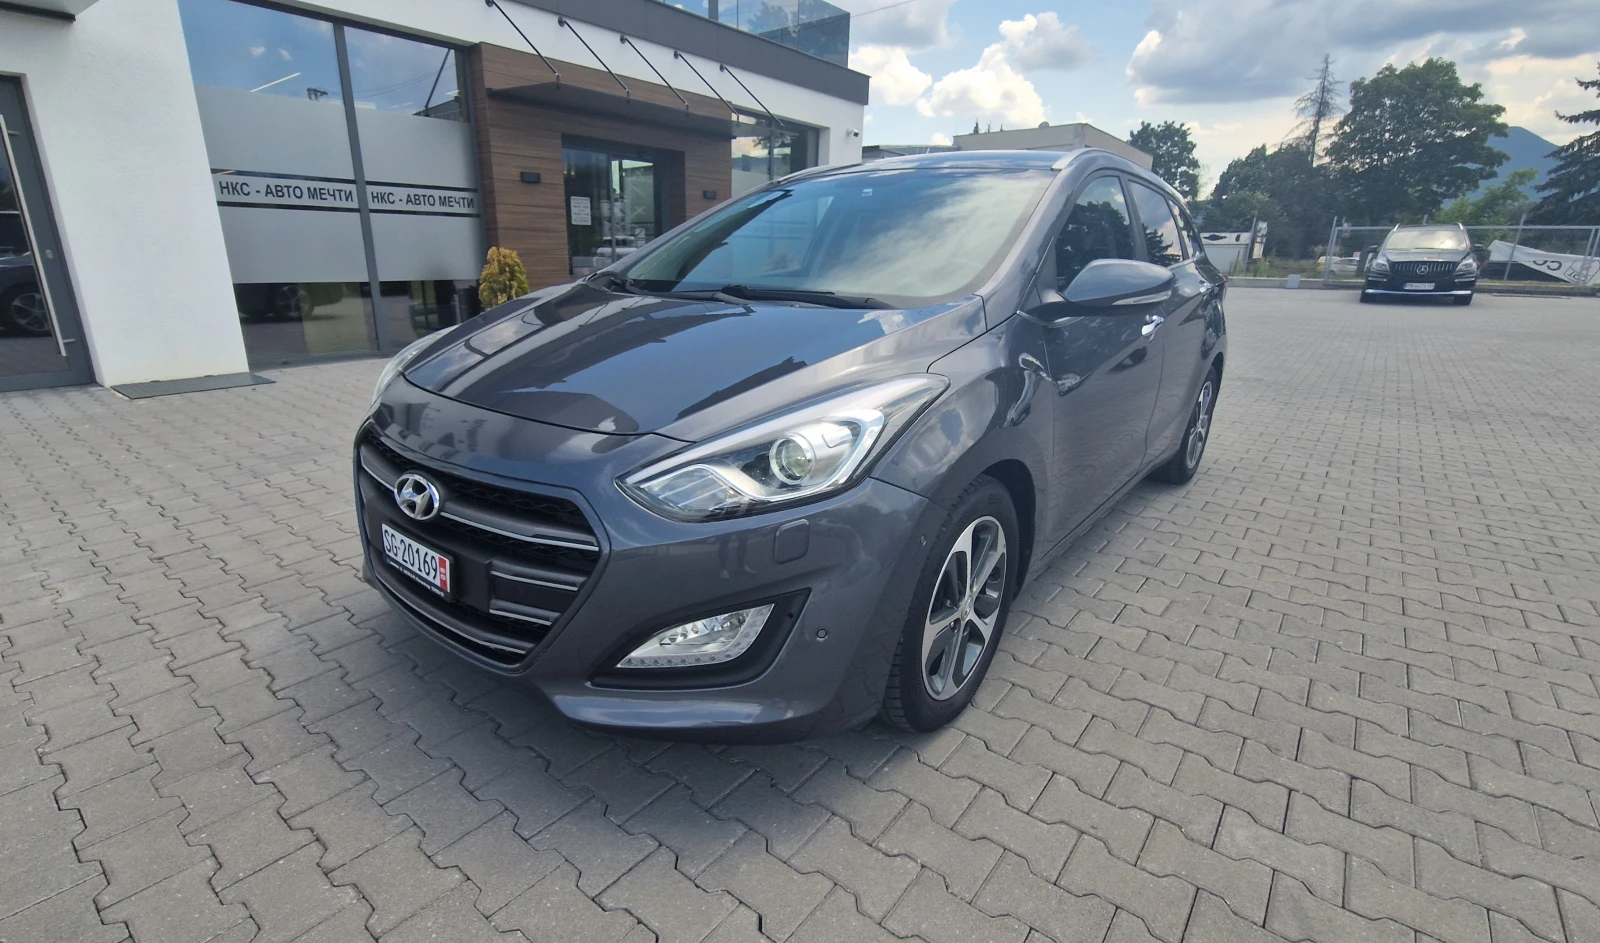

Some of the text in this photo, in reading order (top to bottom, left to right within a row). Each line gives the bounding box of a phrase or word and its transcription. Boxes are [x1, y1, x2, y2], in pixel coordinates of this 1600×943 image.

[219, 181, 251, 196] НКС
[265, 184, 303, 199] АВТО
[307, 186, 354, 202] МЕЧТИ
[371, 191, 395, 205] НКС
[405, 193, 436, 207] АВТО
[438, 195, 475, 209] МЕЧТИ
